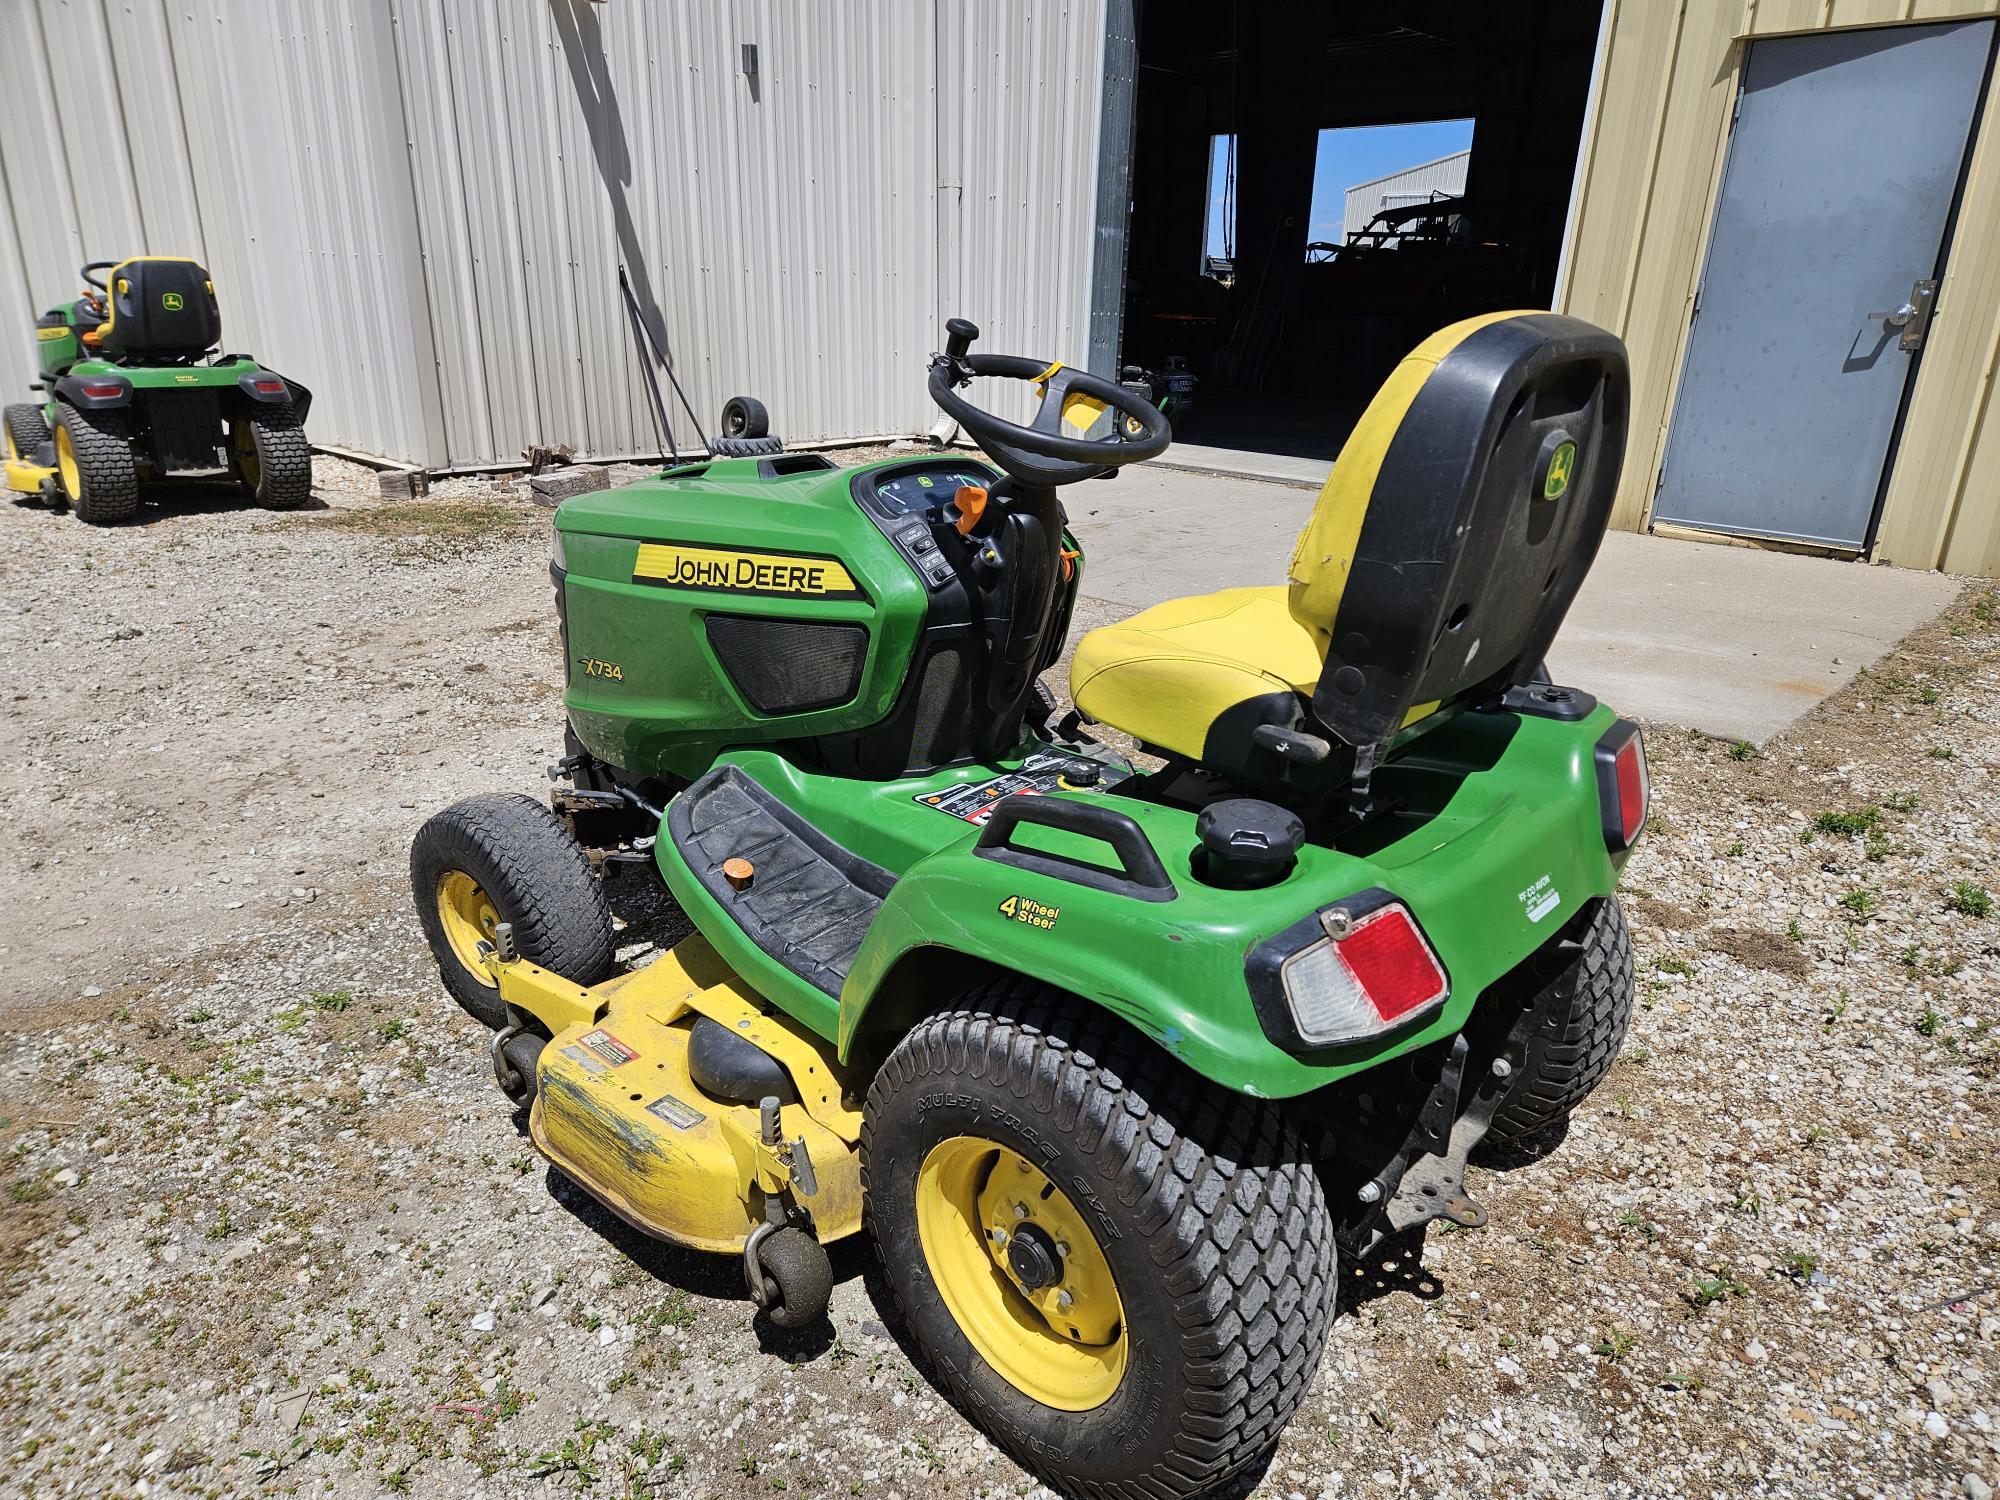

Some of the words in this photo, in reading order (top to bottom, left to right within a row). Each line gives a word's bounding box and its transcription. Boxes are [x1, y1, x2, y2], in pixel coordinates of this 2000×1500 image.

[667, 556, 730, 584] JOHN
[735, 558, 825, 590] DEERE
[577, 658, 624, 681] X734
[998, 896, 1019, 918] 4
[1020, 898, 1060, 920] Wheel
[1017, 909, 1056, 930] Steer
[917, 1093, 981, 1112] MULTI
[940, 1355, 1065, 1463] CARLISLE
